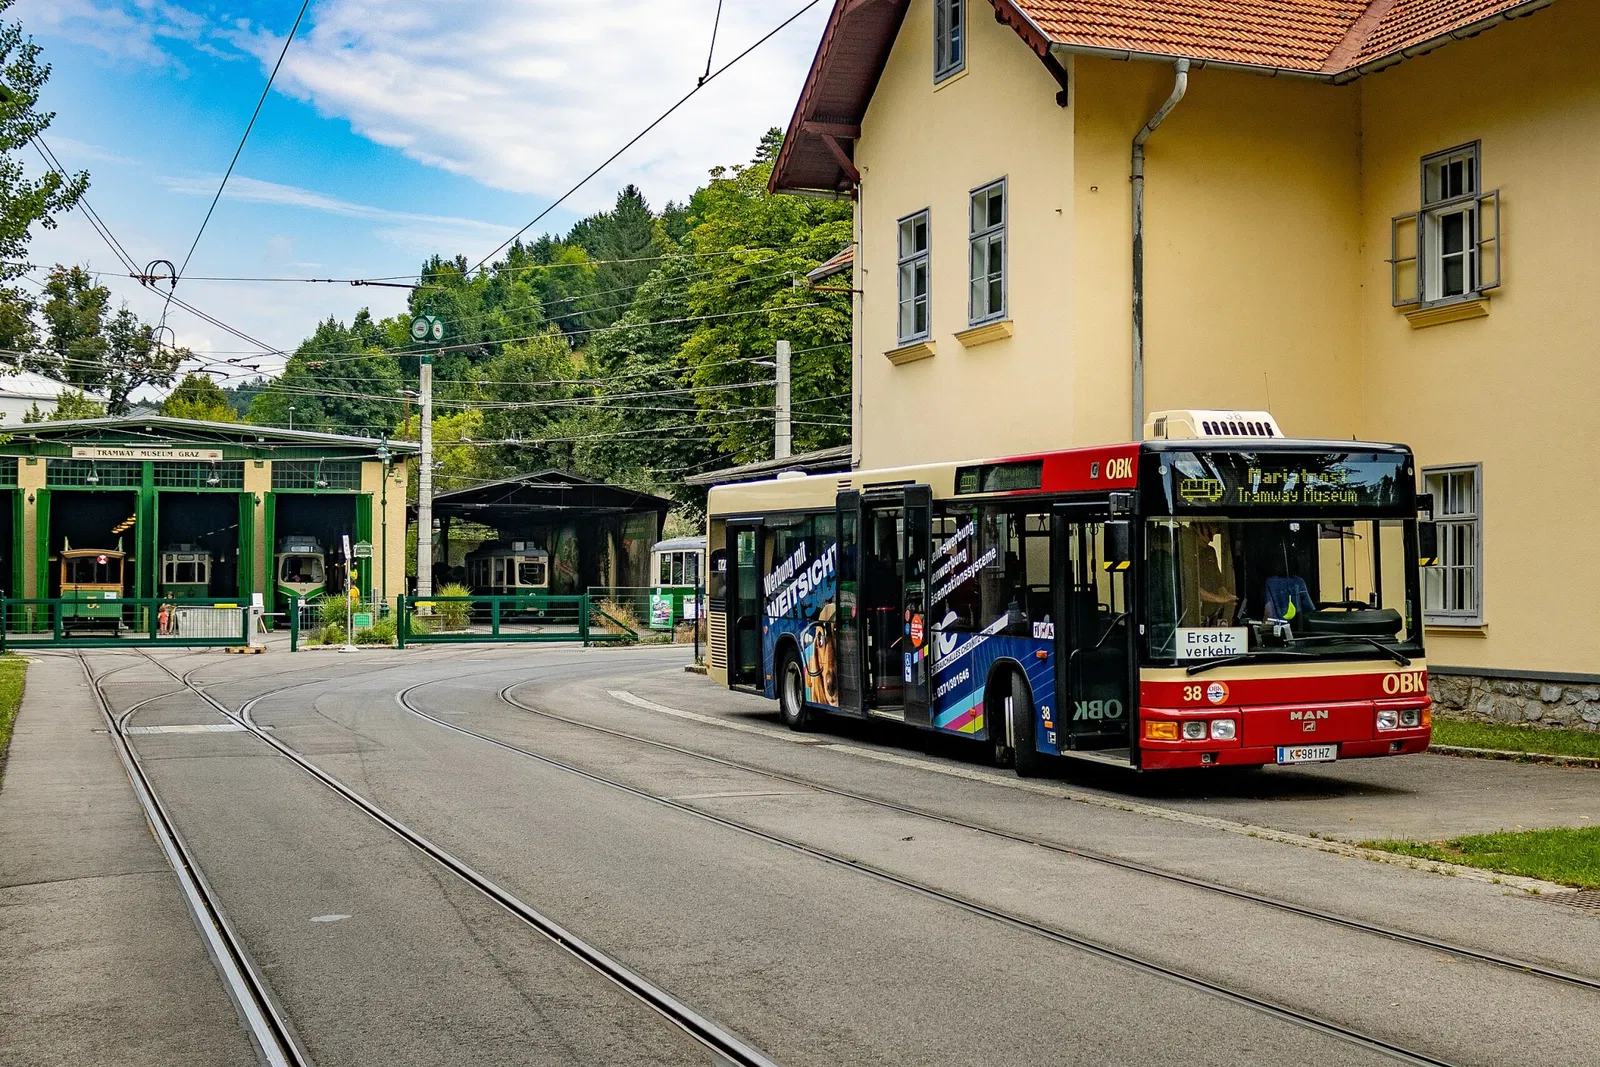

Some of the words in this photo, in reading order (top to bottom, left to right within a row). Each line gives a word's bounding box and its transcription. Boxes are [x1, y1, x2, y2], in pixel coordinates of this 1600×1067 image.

[1105, 457, 1133, 480] OBK
[1238, 487, 1299, 503] Tramway
[1303, 487, 1358, 503] Museum
[764, 556, 794, 597] Werbung
[794, 541, 807, 570] mit
[1187, 632, 1235, 644] Ersatz-
[1186, 645, 1237, 657] verkehr
[1382, 672, 1425, 695] OBK
[1183, 686, 1203, 701] 38
[1041, 705, 1051, 720] 38
[1290, 710, 1329, 720] MAN
